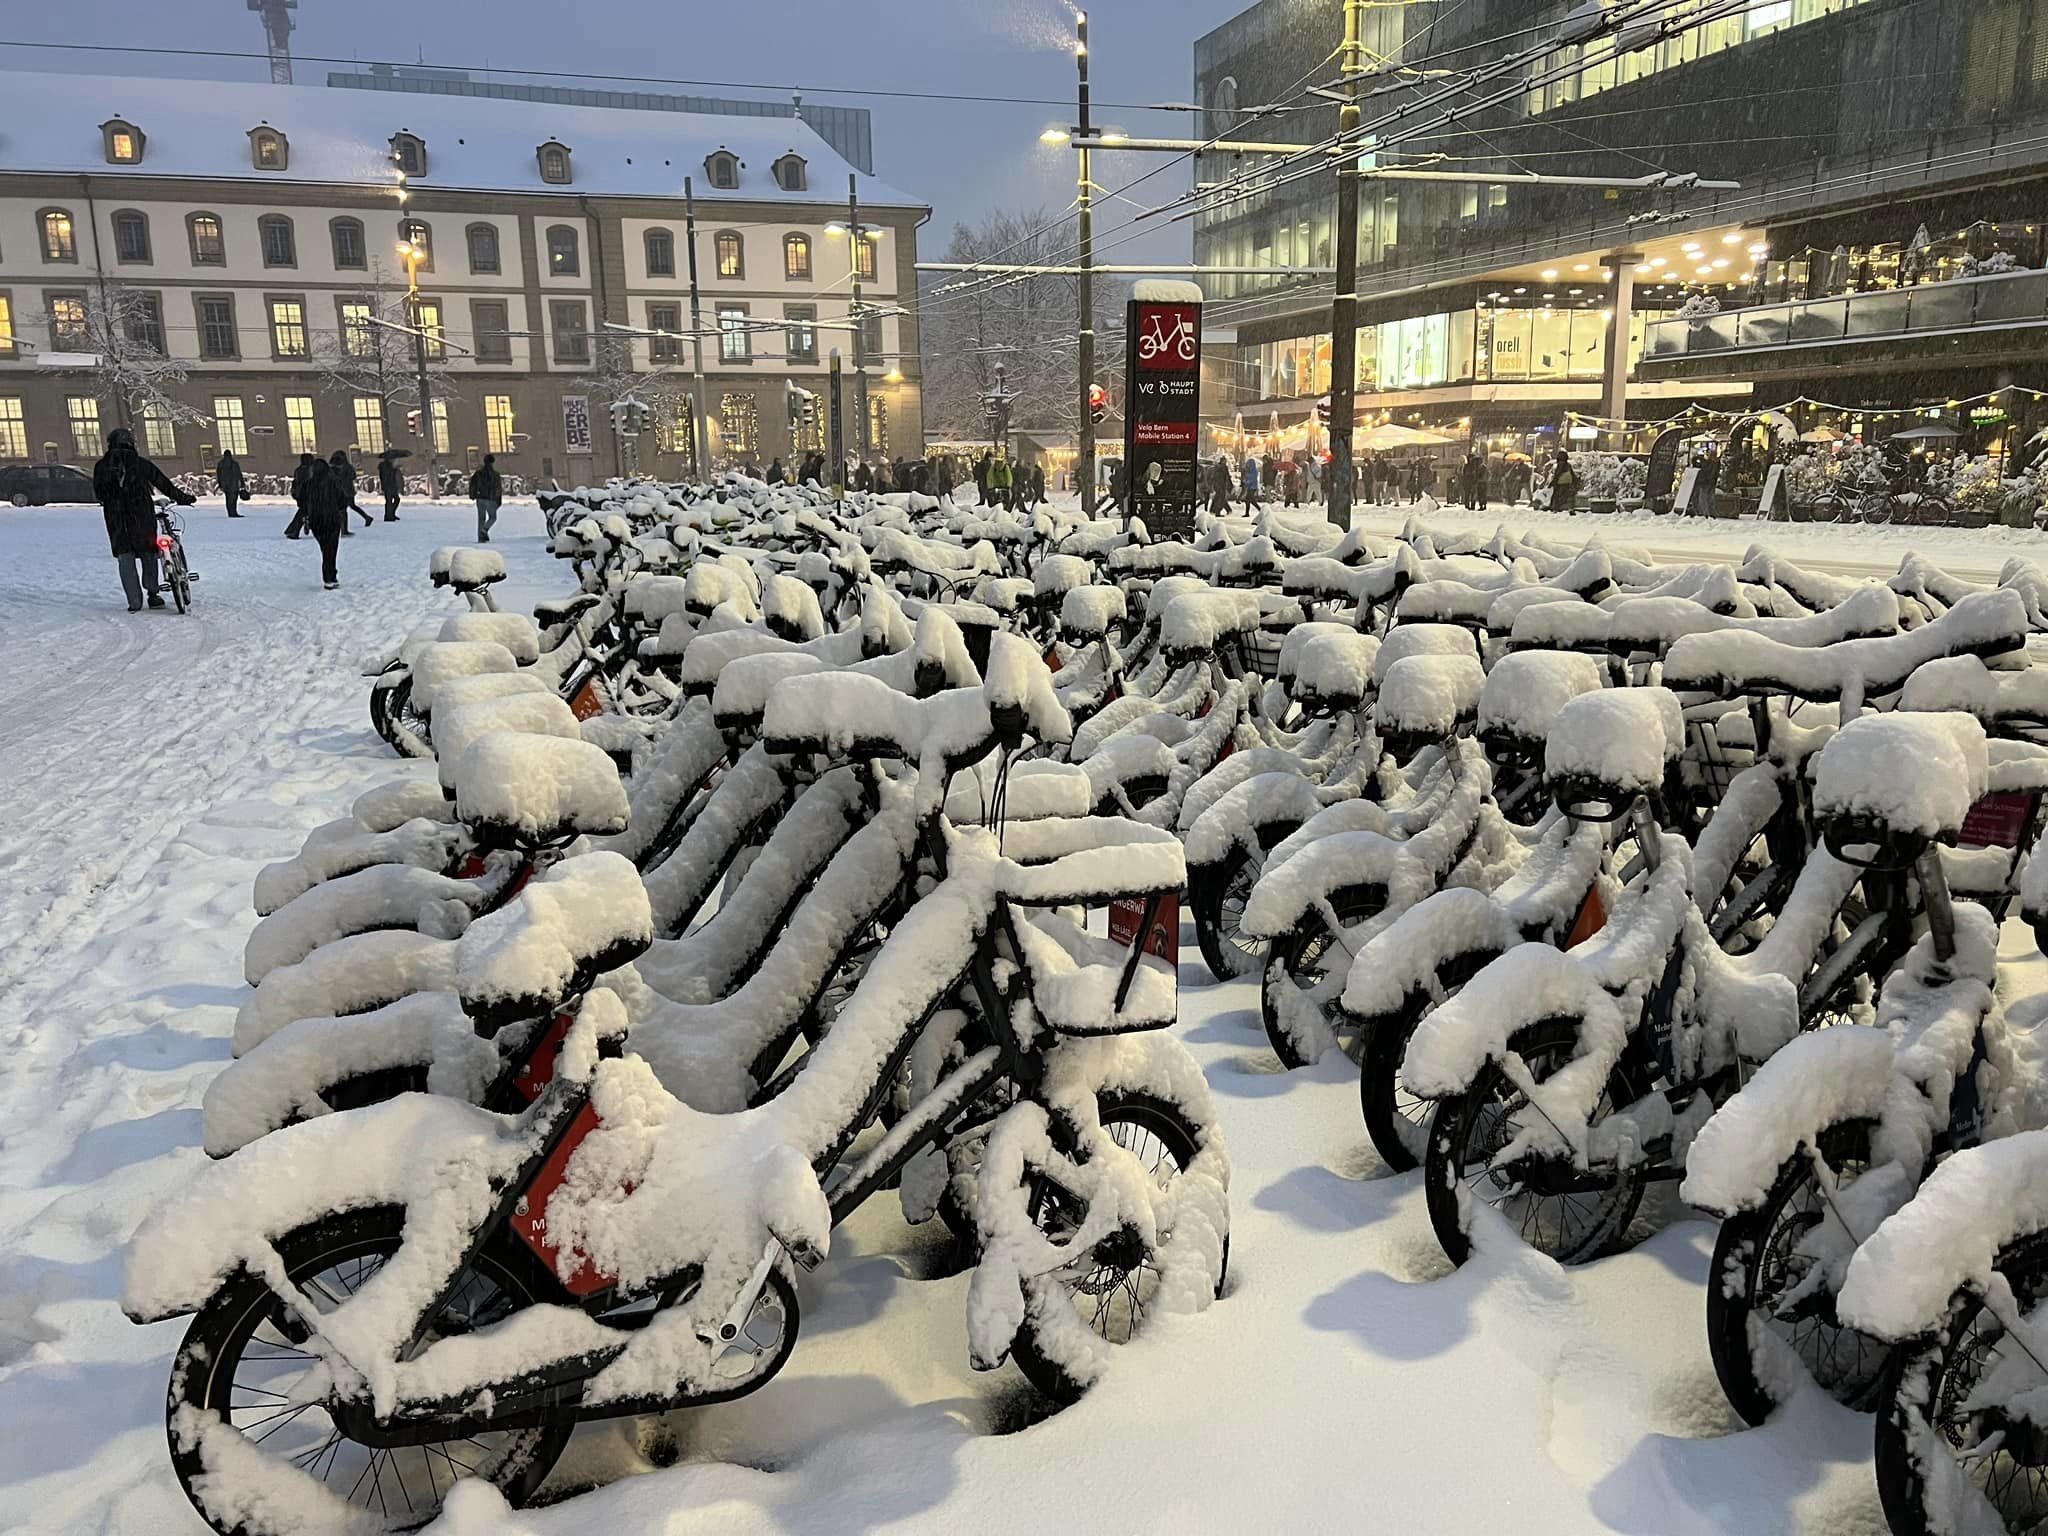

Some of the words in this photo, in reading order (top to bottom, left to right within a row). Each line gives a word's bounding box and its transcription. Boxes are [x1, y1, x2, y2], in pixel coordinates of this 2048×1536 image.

[1496, 335, 1520, 353] orell
[1138, 432, 1160, 440] Mobile
[1161, 432, 1184, 440] Station
